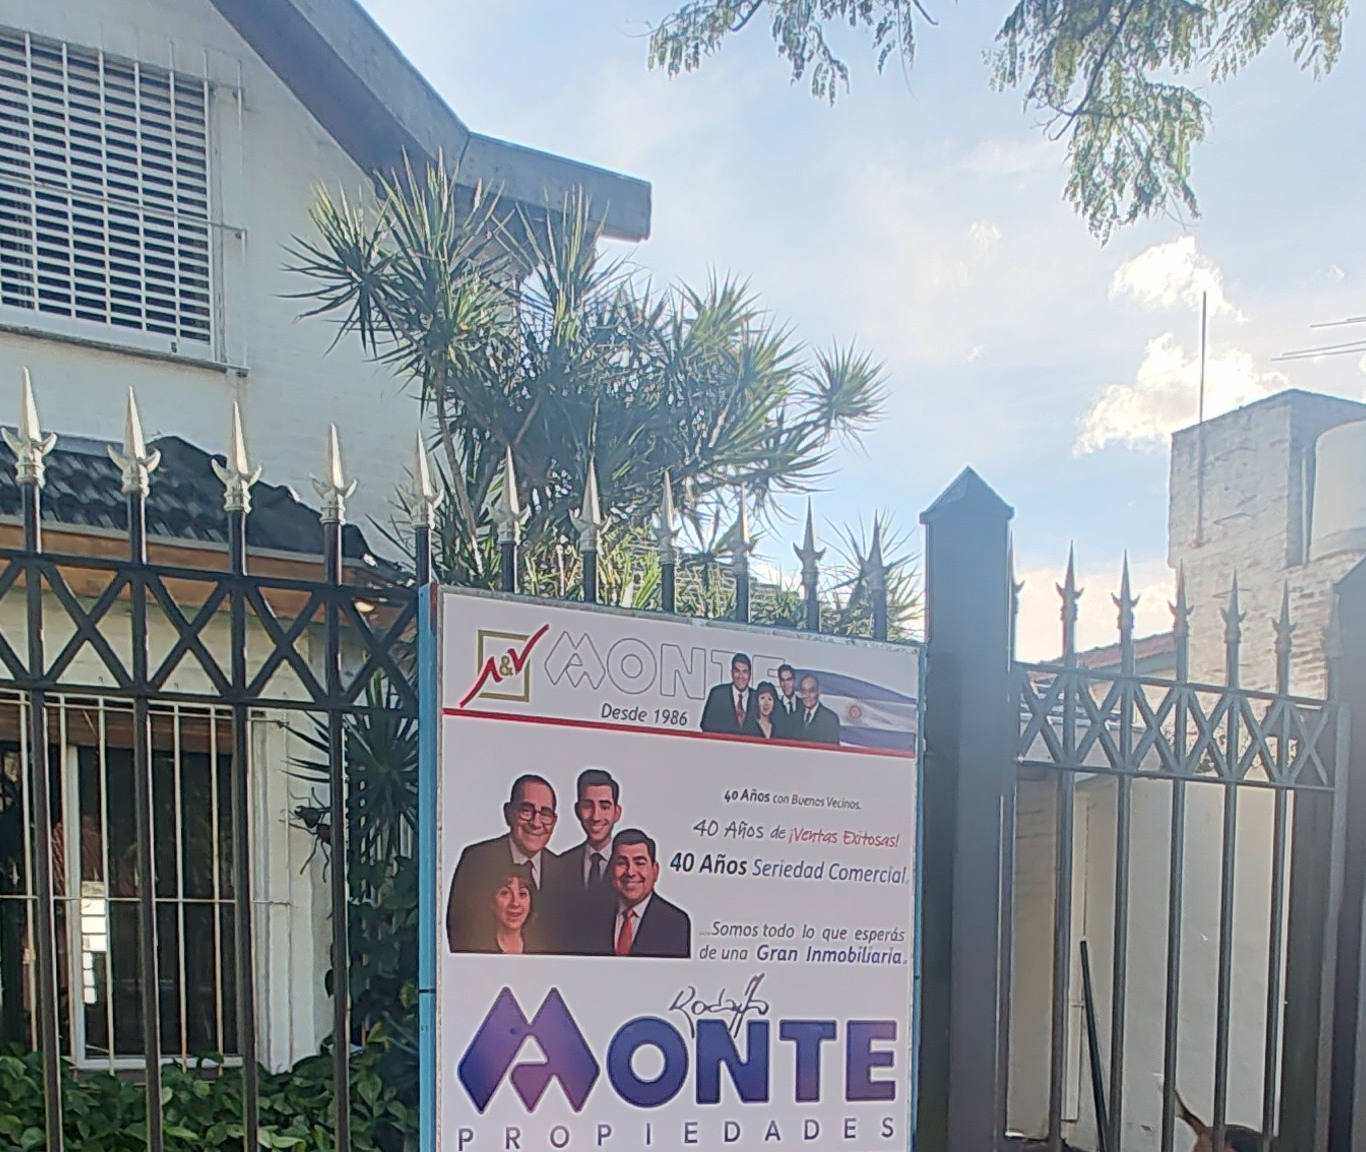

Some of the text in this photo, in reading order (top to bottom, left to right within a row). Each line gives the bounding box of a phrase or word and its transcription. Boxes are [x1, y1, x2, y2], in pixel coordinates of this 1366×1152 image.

[601, 703, 688, 727] Desde 1986
[724, 789, 739, 803] 40
[740, 787, 770, 804] Años
[772, 794, 789, 804] con
[791, 794, 825, 807] Buenos
[693, 819, 900, 848] 40 Años de ¡Ventas Exitosas!
[670, 852, 695, 872] 40
[698, 853, 748, 876] Años
[752, 858, 824, 880] Seriedad
[763, 923, 795, 939] todo
[802, 923, 815, 939] lo
[822, 927, 848, 942] que
[854, 927, 906, 944] esperás
[699, 944, 718, 960] de
[721, 946, 748, 960] una
[757, 944, 798, 962] Gran
[457, 986, 898, 1114] MONTE
[457, 1117, 895, 1151] PROPIEDADES
